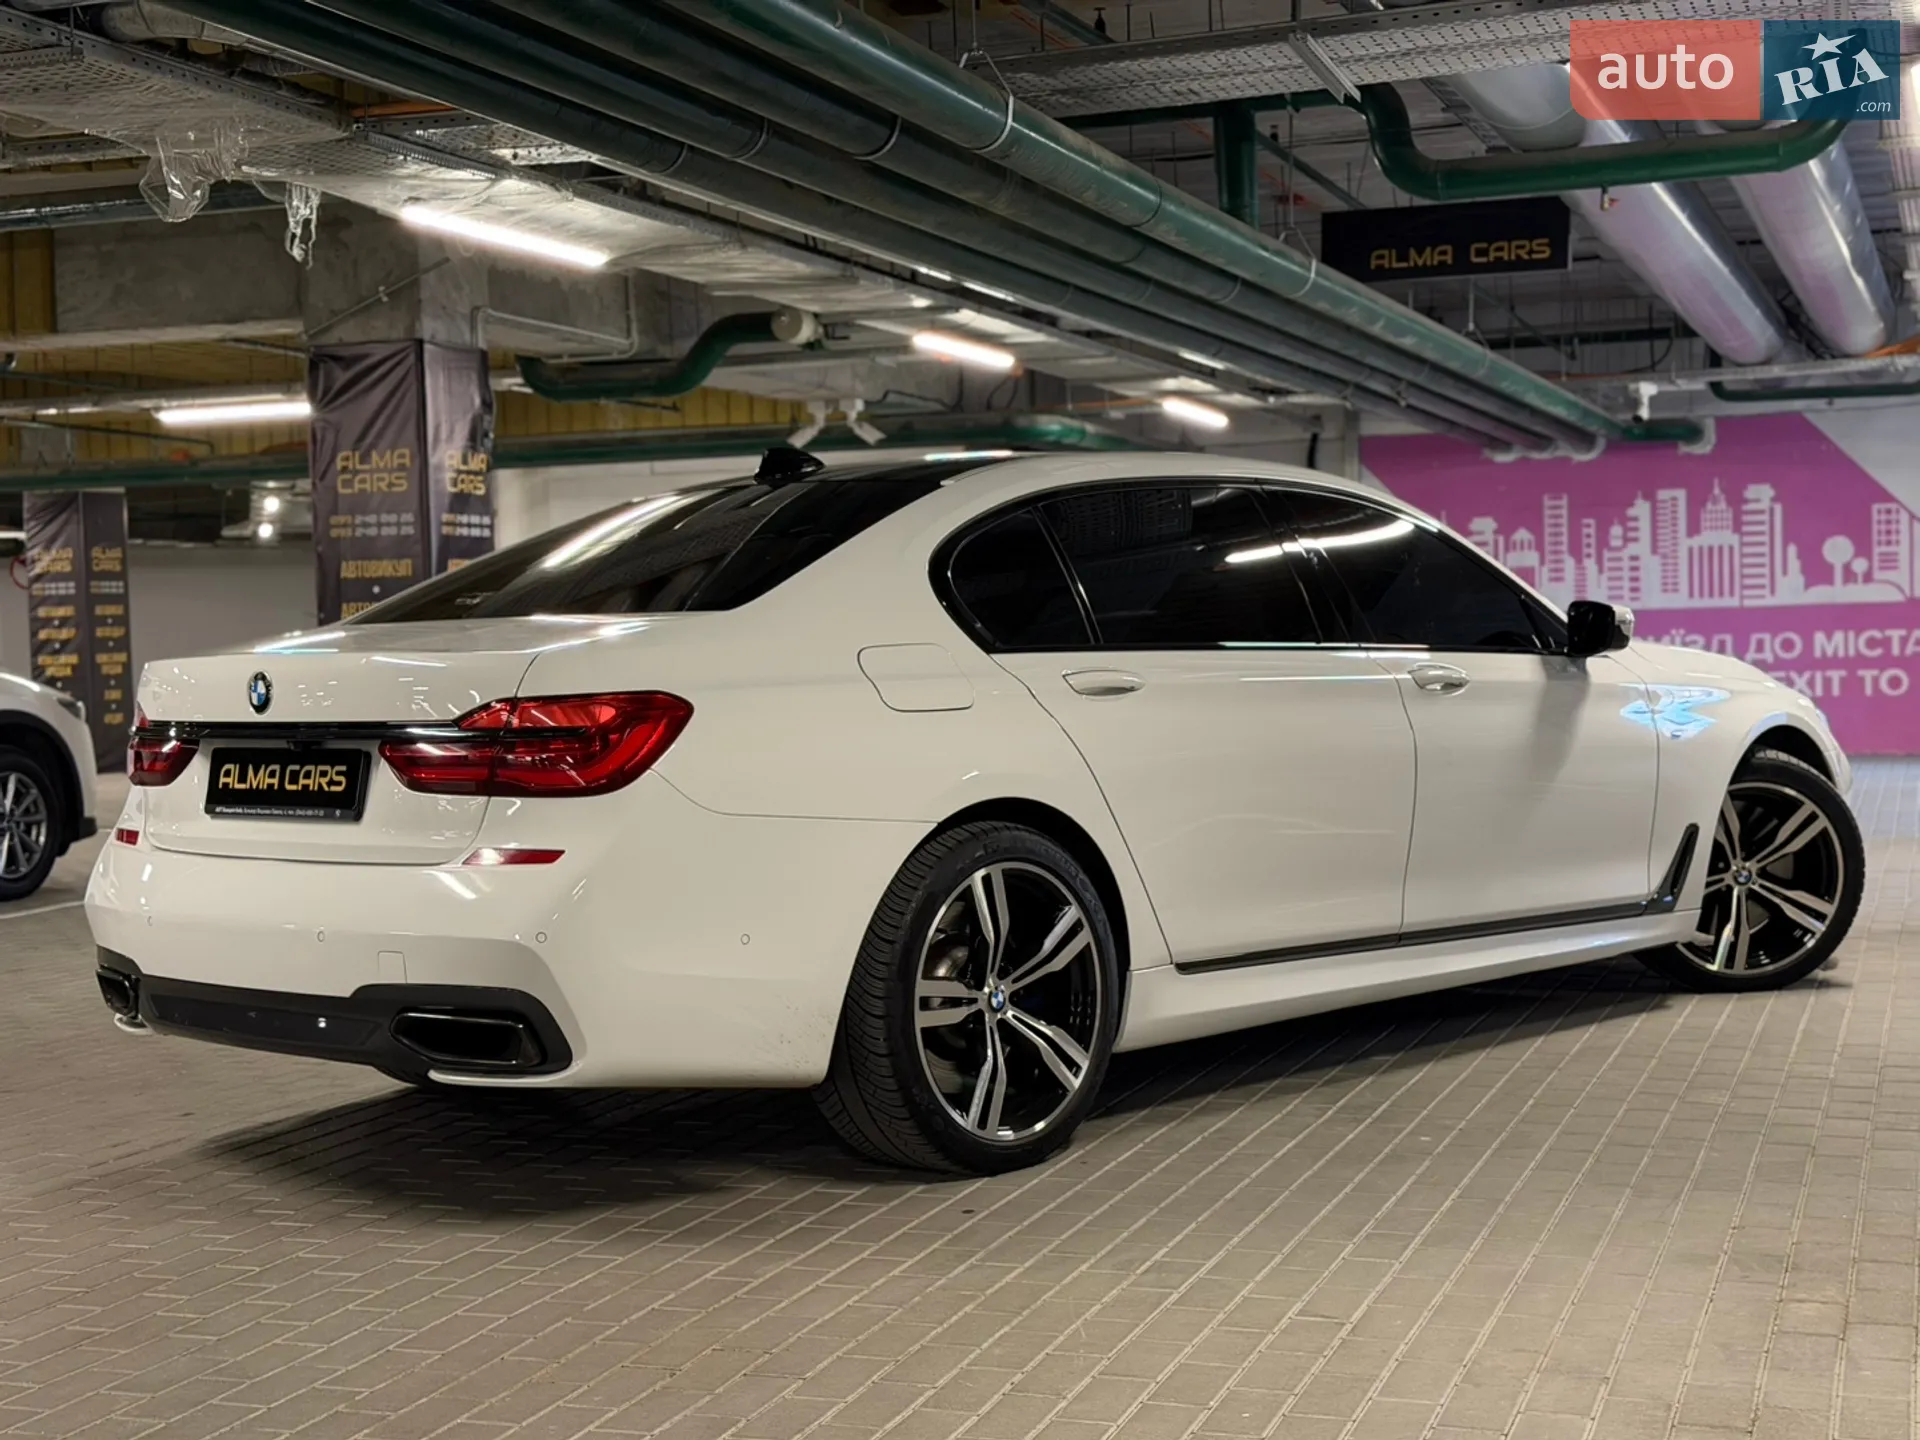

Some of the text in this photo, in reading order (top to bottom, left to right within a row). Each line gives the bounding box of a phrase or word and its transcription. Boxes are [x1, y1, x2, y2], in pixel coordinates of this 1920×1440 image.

[1370, 238, 1551, 270] ALMA CARS
[336, 449, 411, 471] ALMA
[337, 472, 408, 494] CARS
[447, 472, 486, 496] CARS
[1745, 632, 1803, 664] ДО
[1813, 628, 1920, 658] МІСТА
[1857, 667, 1909, 696] TO
[218, 763, 347, 792] ALMA CARS
